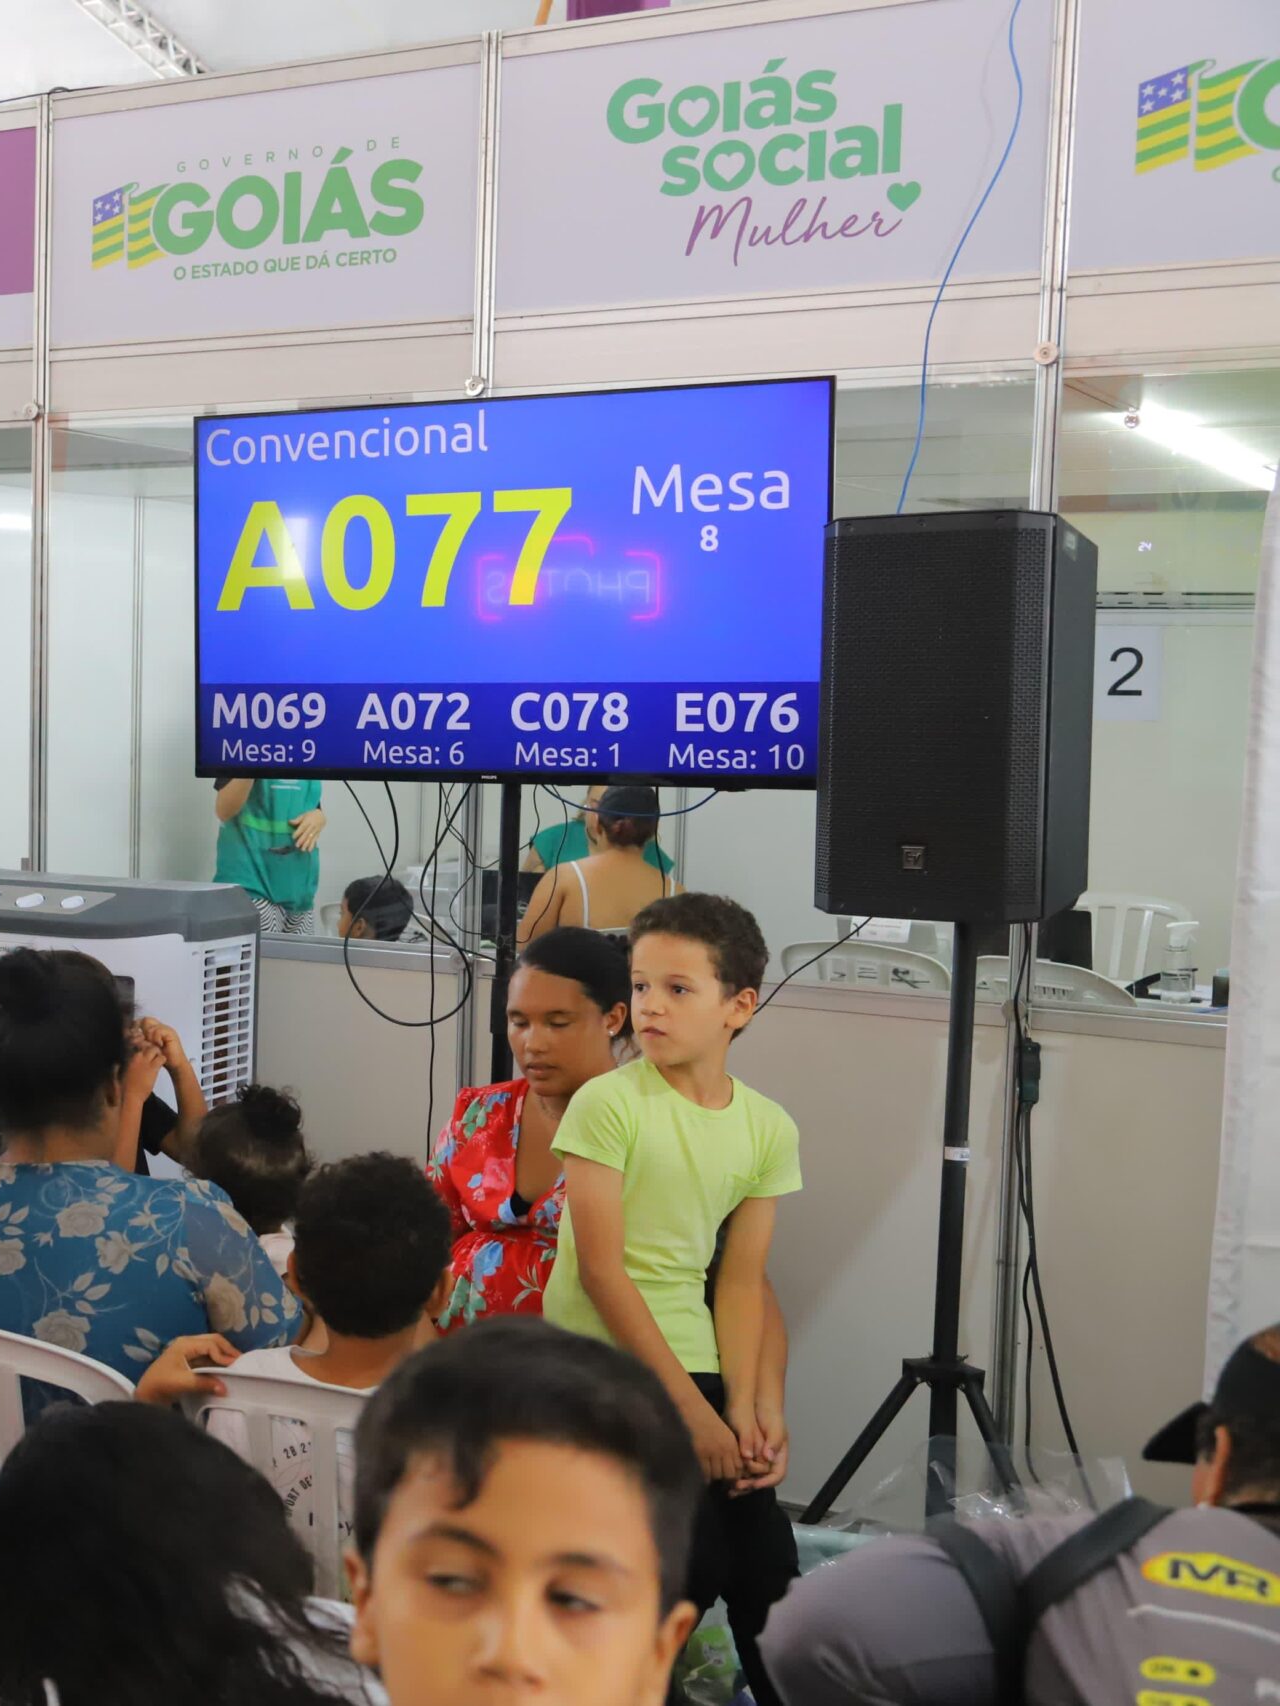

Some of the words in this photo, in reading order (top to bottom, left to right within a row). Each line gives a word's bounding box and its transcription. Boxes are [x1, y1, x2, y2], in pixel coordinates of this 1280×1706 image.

[606, 57, 837, 145] Goiás
[177, 146, 324, 173] GOVERNO
[366, 136, 401, 152] DE
[659, 103, 904, 197] social
[152, 146, 425, 256] GOIÁS
[685, 196, 902, 267] Mulher
[173, 266, 187, 281] O
[191, 259, 259, 280] ESTADO
[263, 255, 302, 275] QUE
[306, 250, 331, 270] DÁ
[335, 247, 398, 268] CERTO
[206, 410, 488, 467] Convencional
[632, 463, 792, 516] Mesa
[216, 487, 573, 612] A077
[699, 525, 719, 552] 8
[1107, 647, 1144, 697] 2
[211, 691, 327, 731] M069
[356, 692, 471, 731] A072
[510, 692, 629, 733] C078
[675, 693, 800, 734] E076
[221, 740, 294, 764] Mesa:
[301, 741, 316, 763] 9
[364, 741, 441, 766] Mesa:
[449, 743, 465, 766] 6
[515, 743, 597, 767] Mesa:
[609, 744, 621, 767] 1
[669, 744, 758, 770] Mesa:
[770, 745, 805, 771] 10
